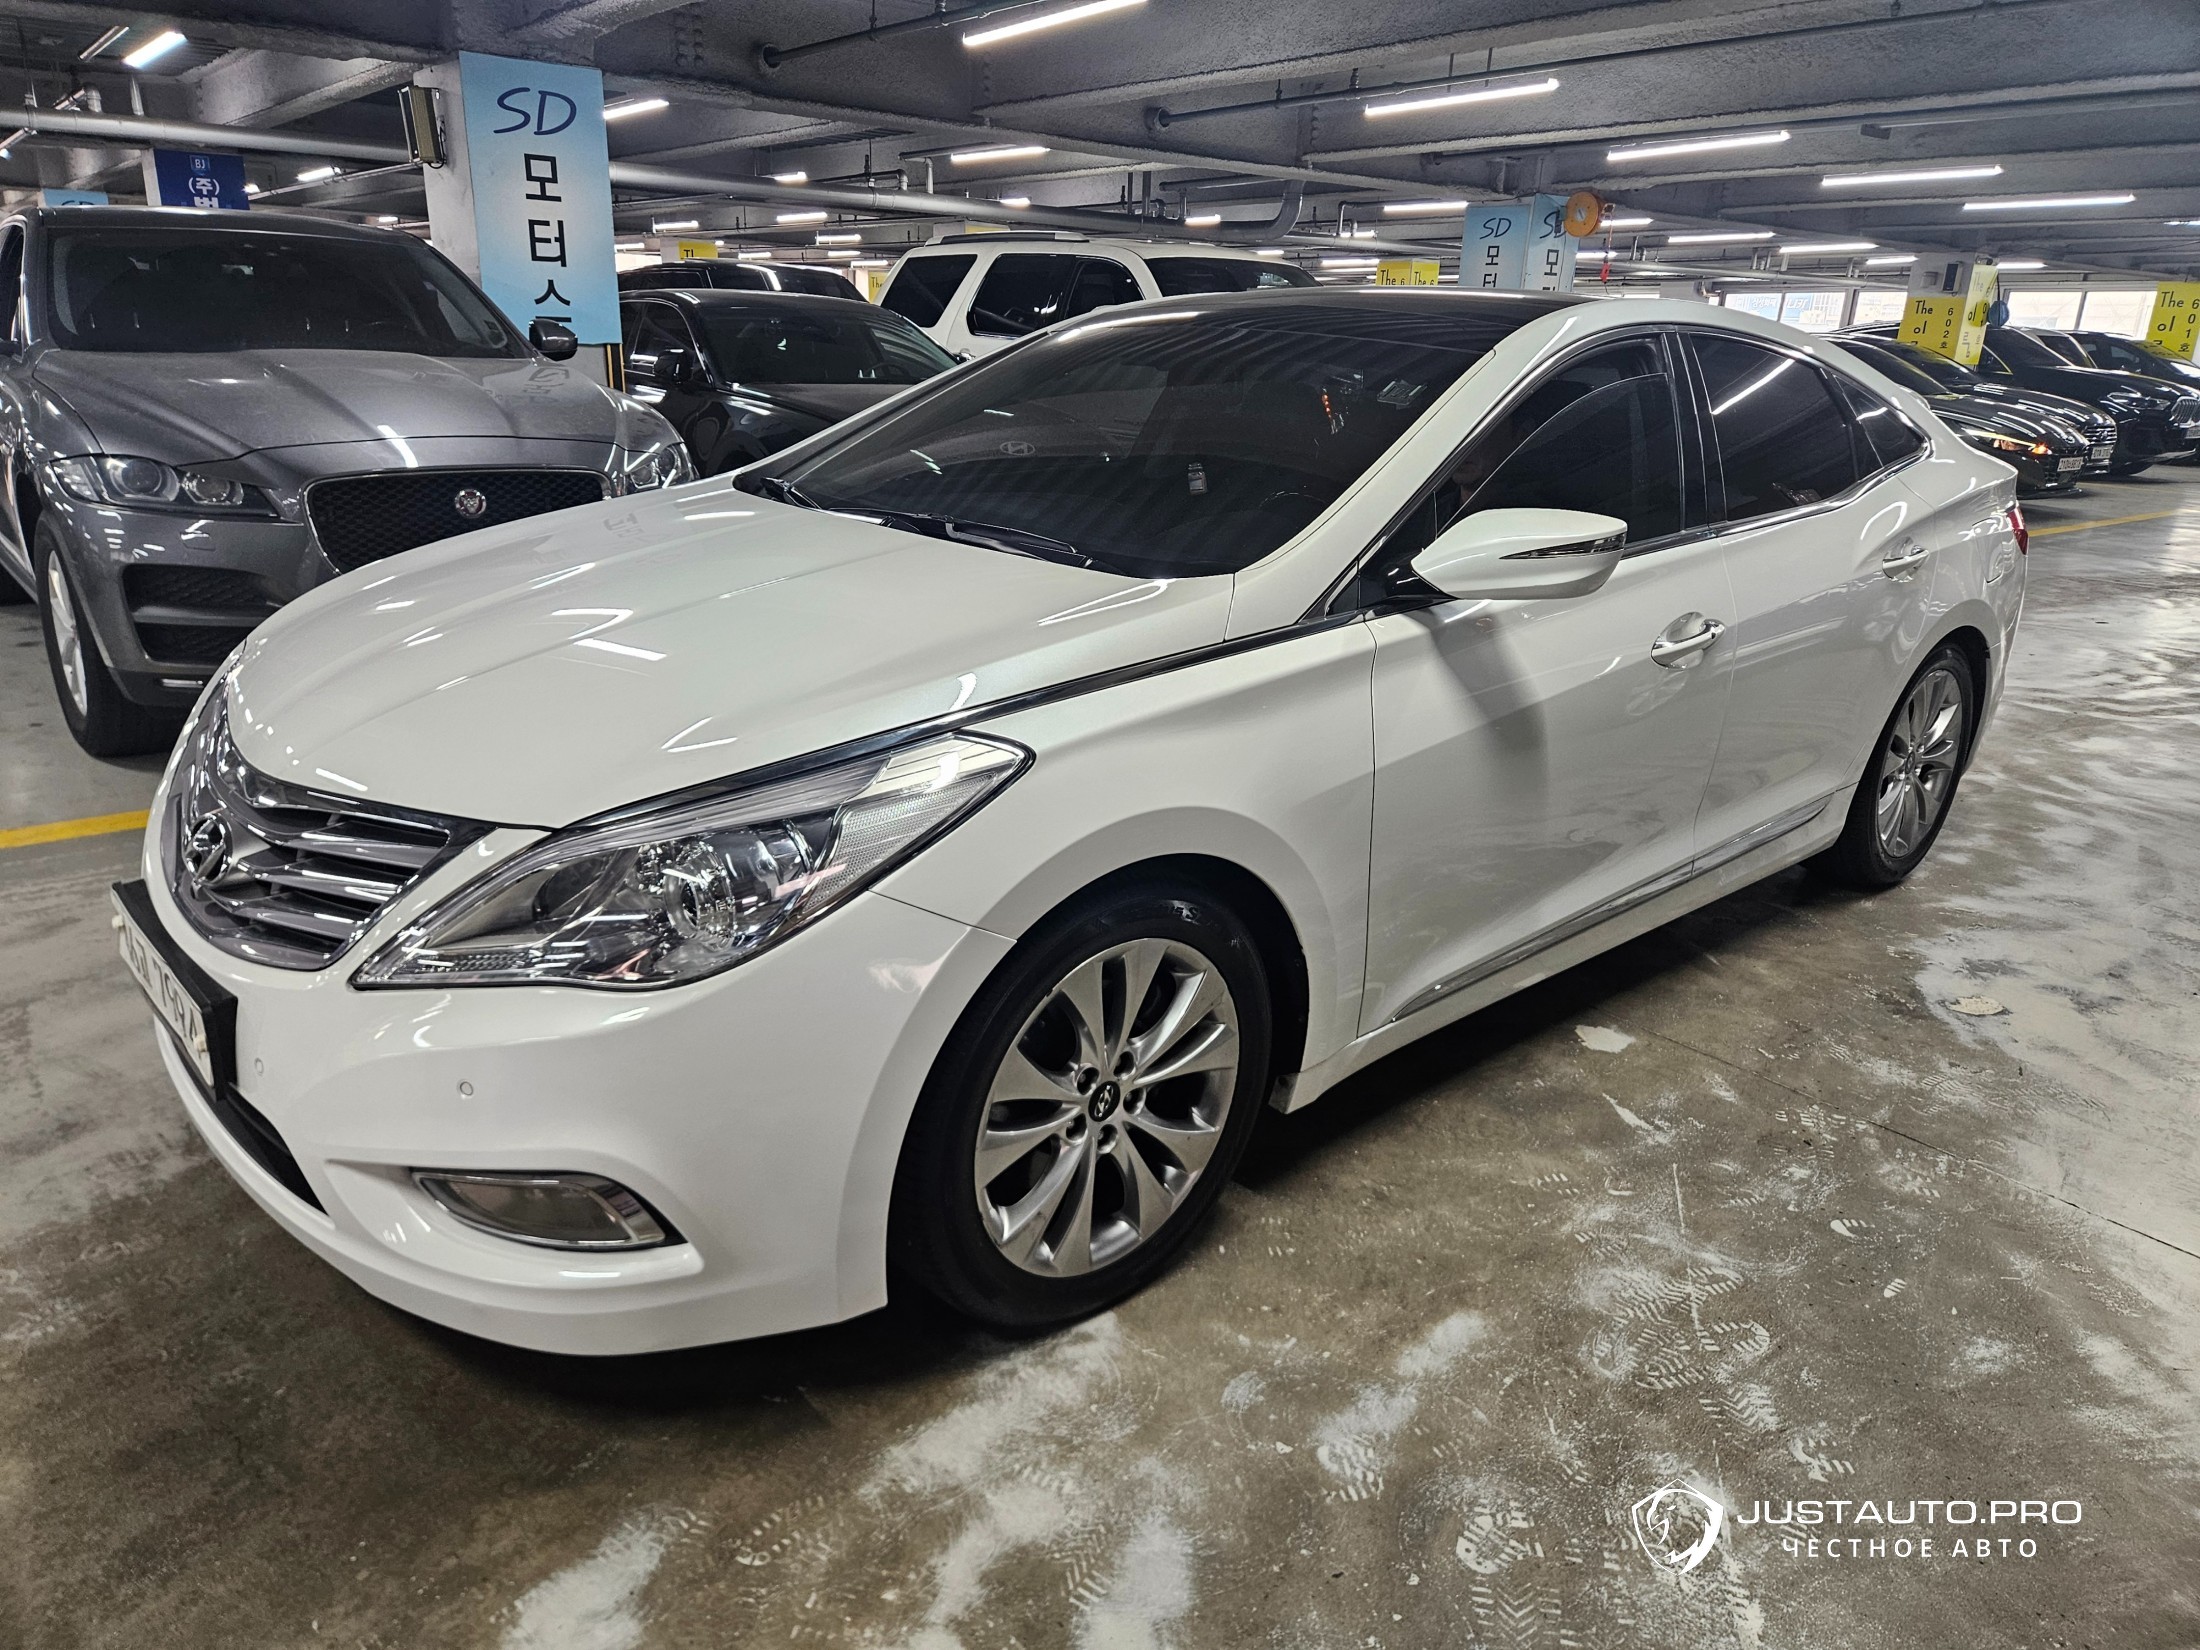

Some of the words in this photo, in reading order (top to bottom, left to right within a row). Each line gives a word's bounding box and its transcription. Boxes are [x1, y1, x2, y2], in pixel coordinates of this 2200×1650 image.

[493, 86, 577, 136] SD
[194, 158, 206, 169] BJ
[188, 177, 220, 196] (주)
[523, 152, 573, 323] 모터스
[1479, 217, 1512, 240] SD
[1915, 299, 1934, 315] The
[2161, 290, 2185, 308] The
